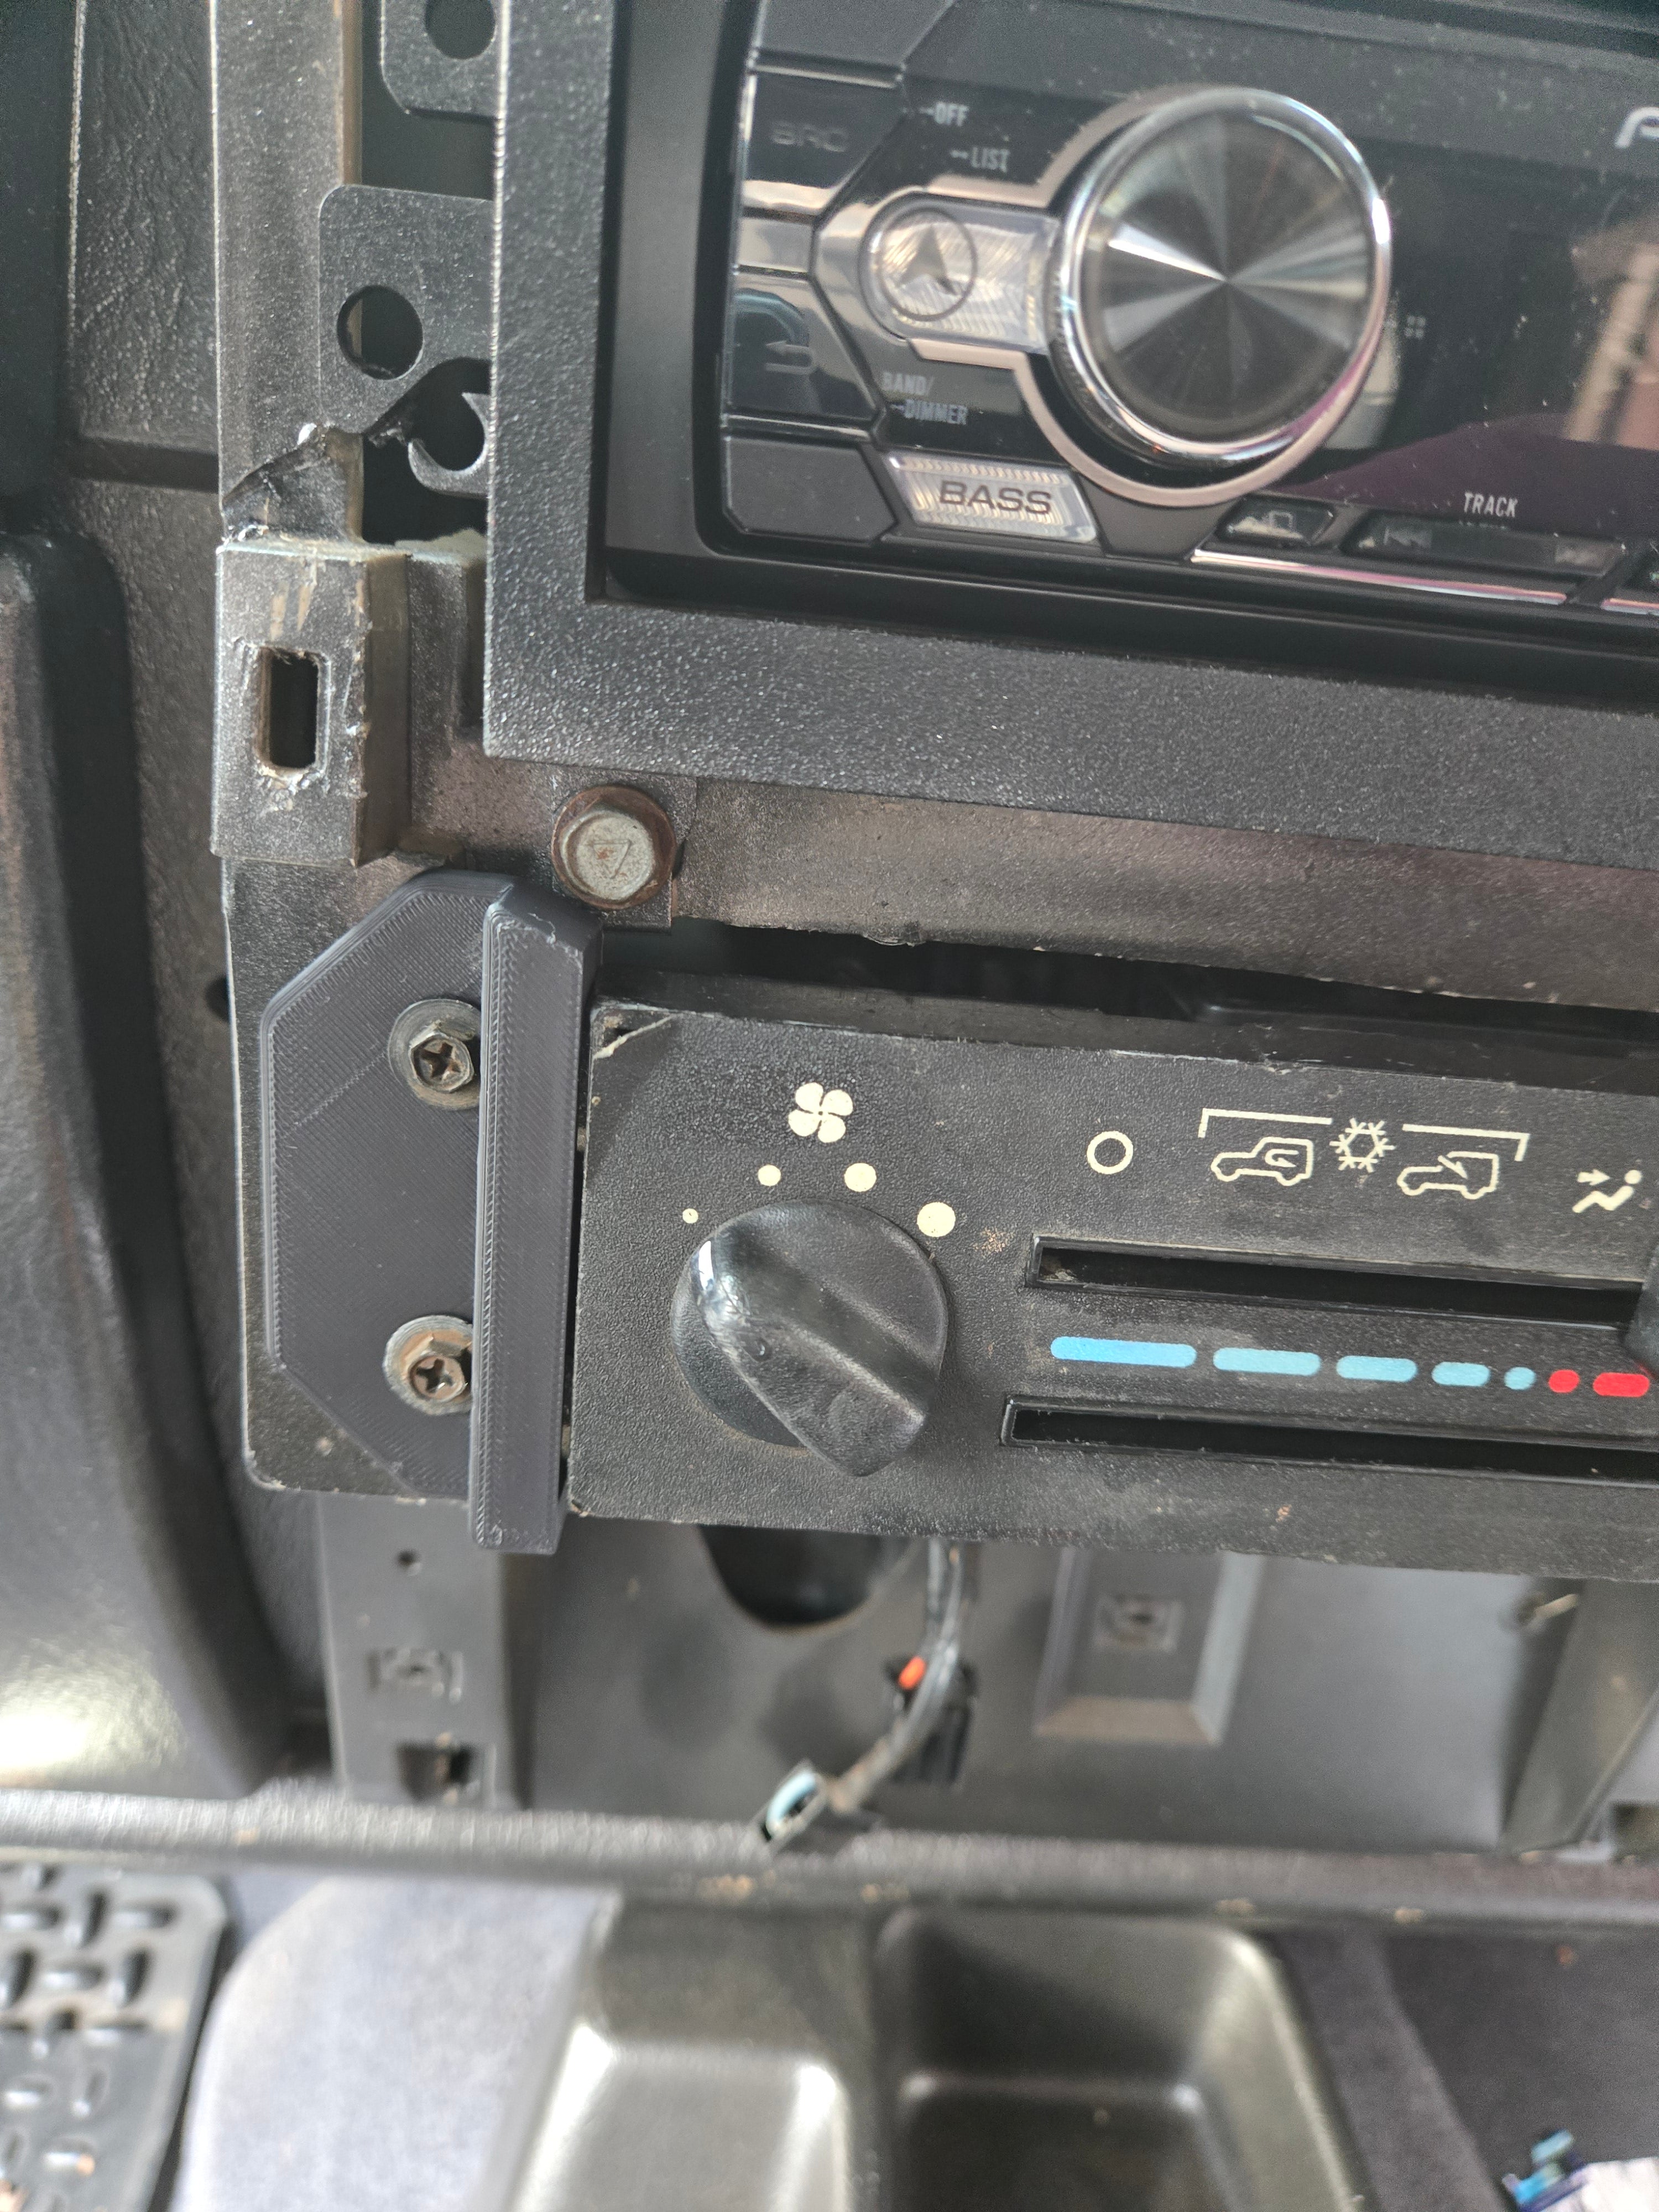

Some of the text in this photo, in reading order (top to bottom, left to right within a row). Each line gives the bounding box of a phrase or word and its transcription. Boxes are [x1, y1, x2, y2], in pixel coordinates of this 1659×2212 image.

[934, 102, 969, 127] OFF
[971, 146, 1010, 173] LIST
[904, 398, 968, 425] DIMMER
[940, 480, 1052, 515] BASS
[1463, 491, 1519, 518] TRACK
